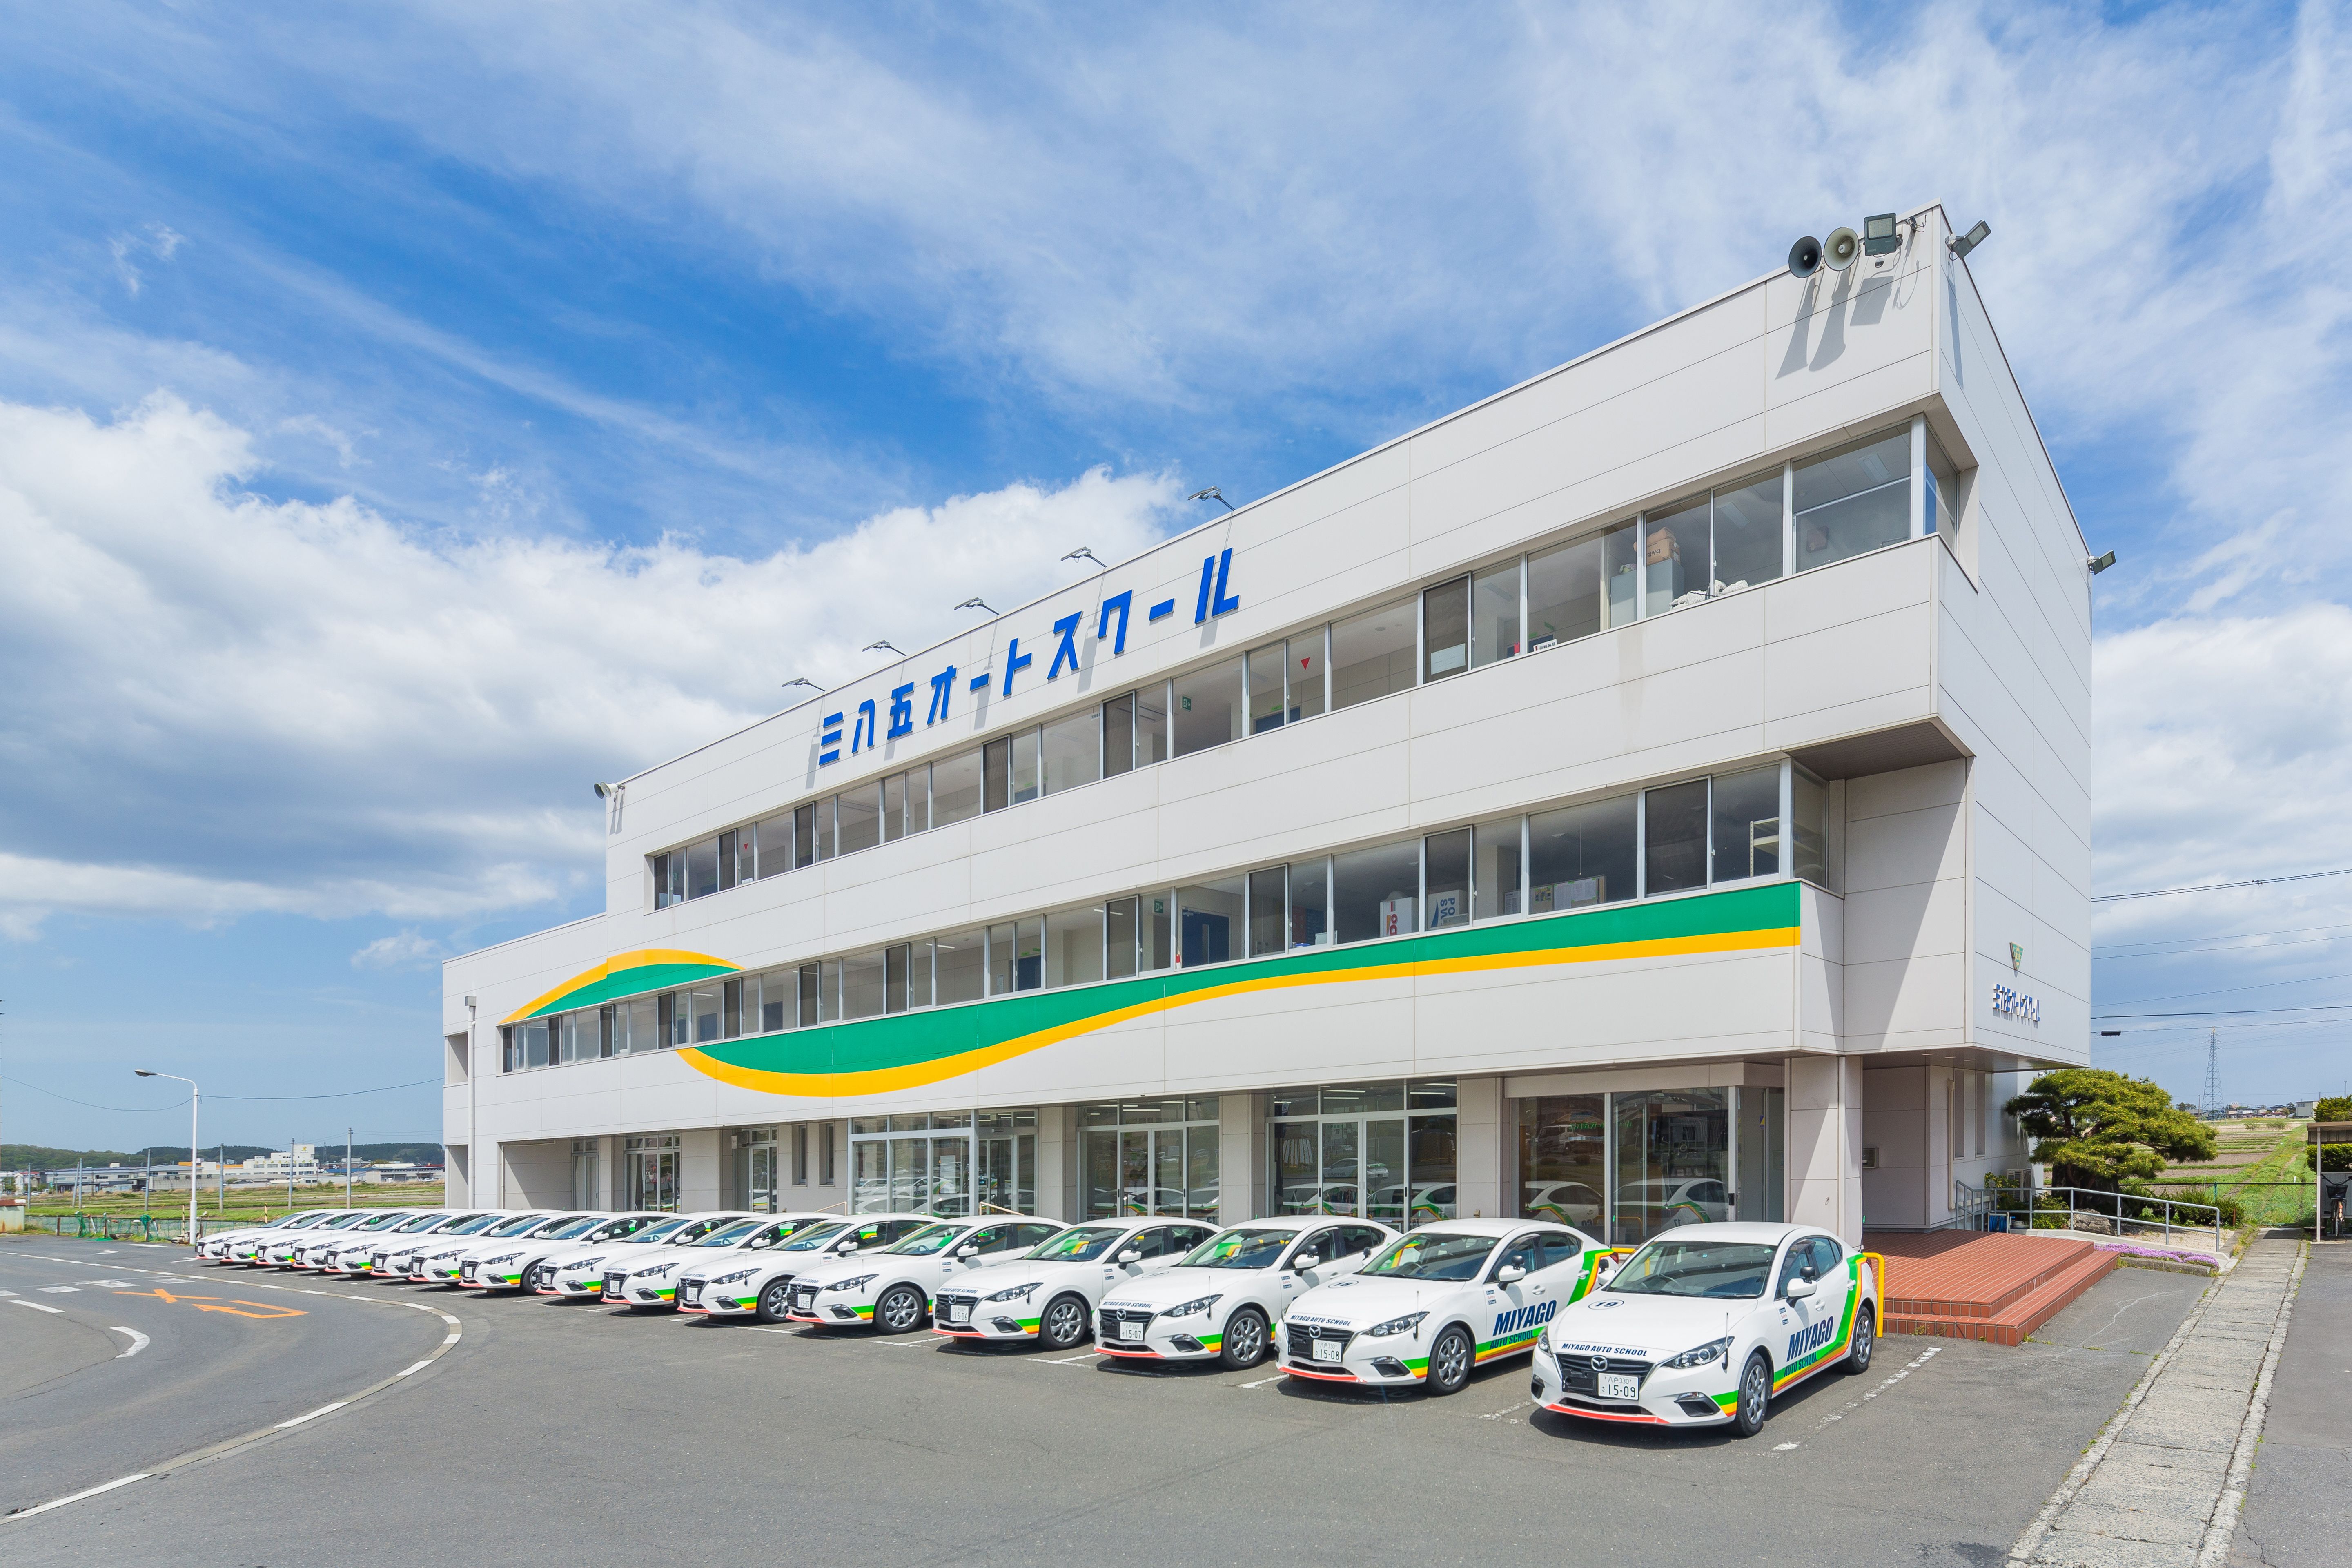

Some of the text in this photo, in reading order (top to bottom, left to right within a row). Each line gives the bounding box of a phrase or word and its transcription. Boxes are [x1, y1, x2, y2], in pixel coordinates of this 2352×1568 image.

[818, 547, 1240, 766] 三八五オートスクール
[1492, 1300, 1557, 1337] MIYAGO
[1125, 1330, 1141, 1339] 15-07
[1489, 1330, 1534, 1350] AUTO SCHOOL
[1786, 1316, 1834, 1362] MIYAGO
[1320, 1349, 1339, 1360] 15-08
[1614, 1348, 1648, 1356] SCHOOL
[1784, 1352, 1818, 1378] AUTO SCHOOL
[1608, 1384, 1636, 1398] 15-09
